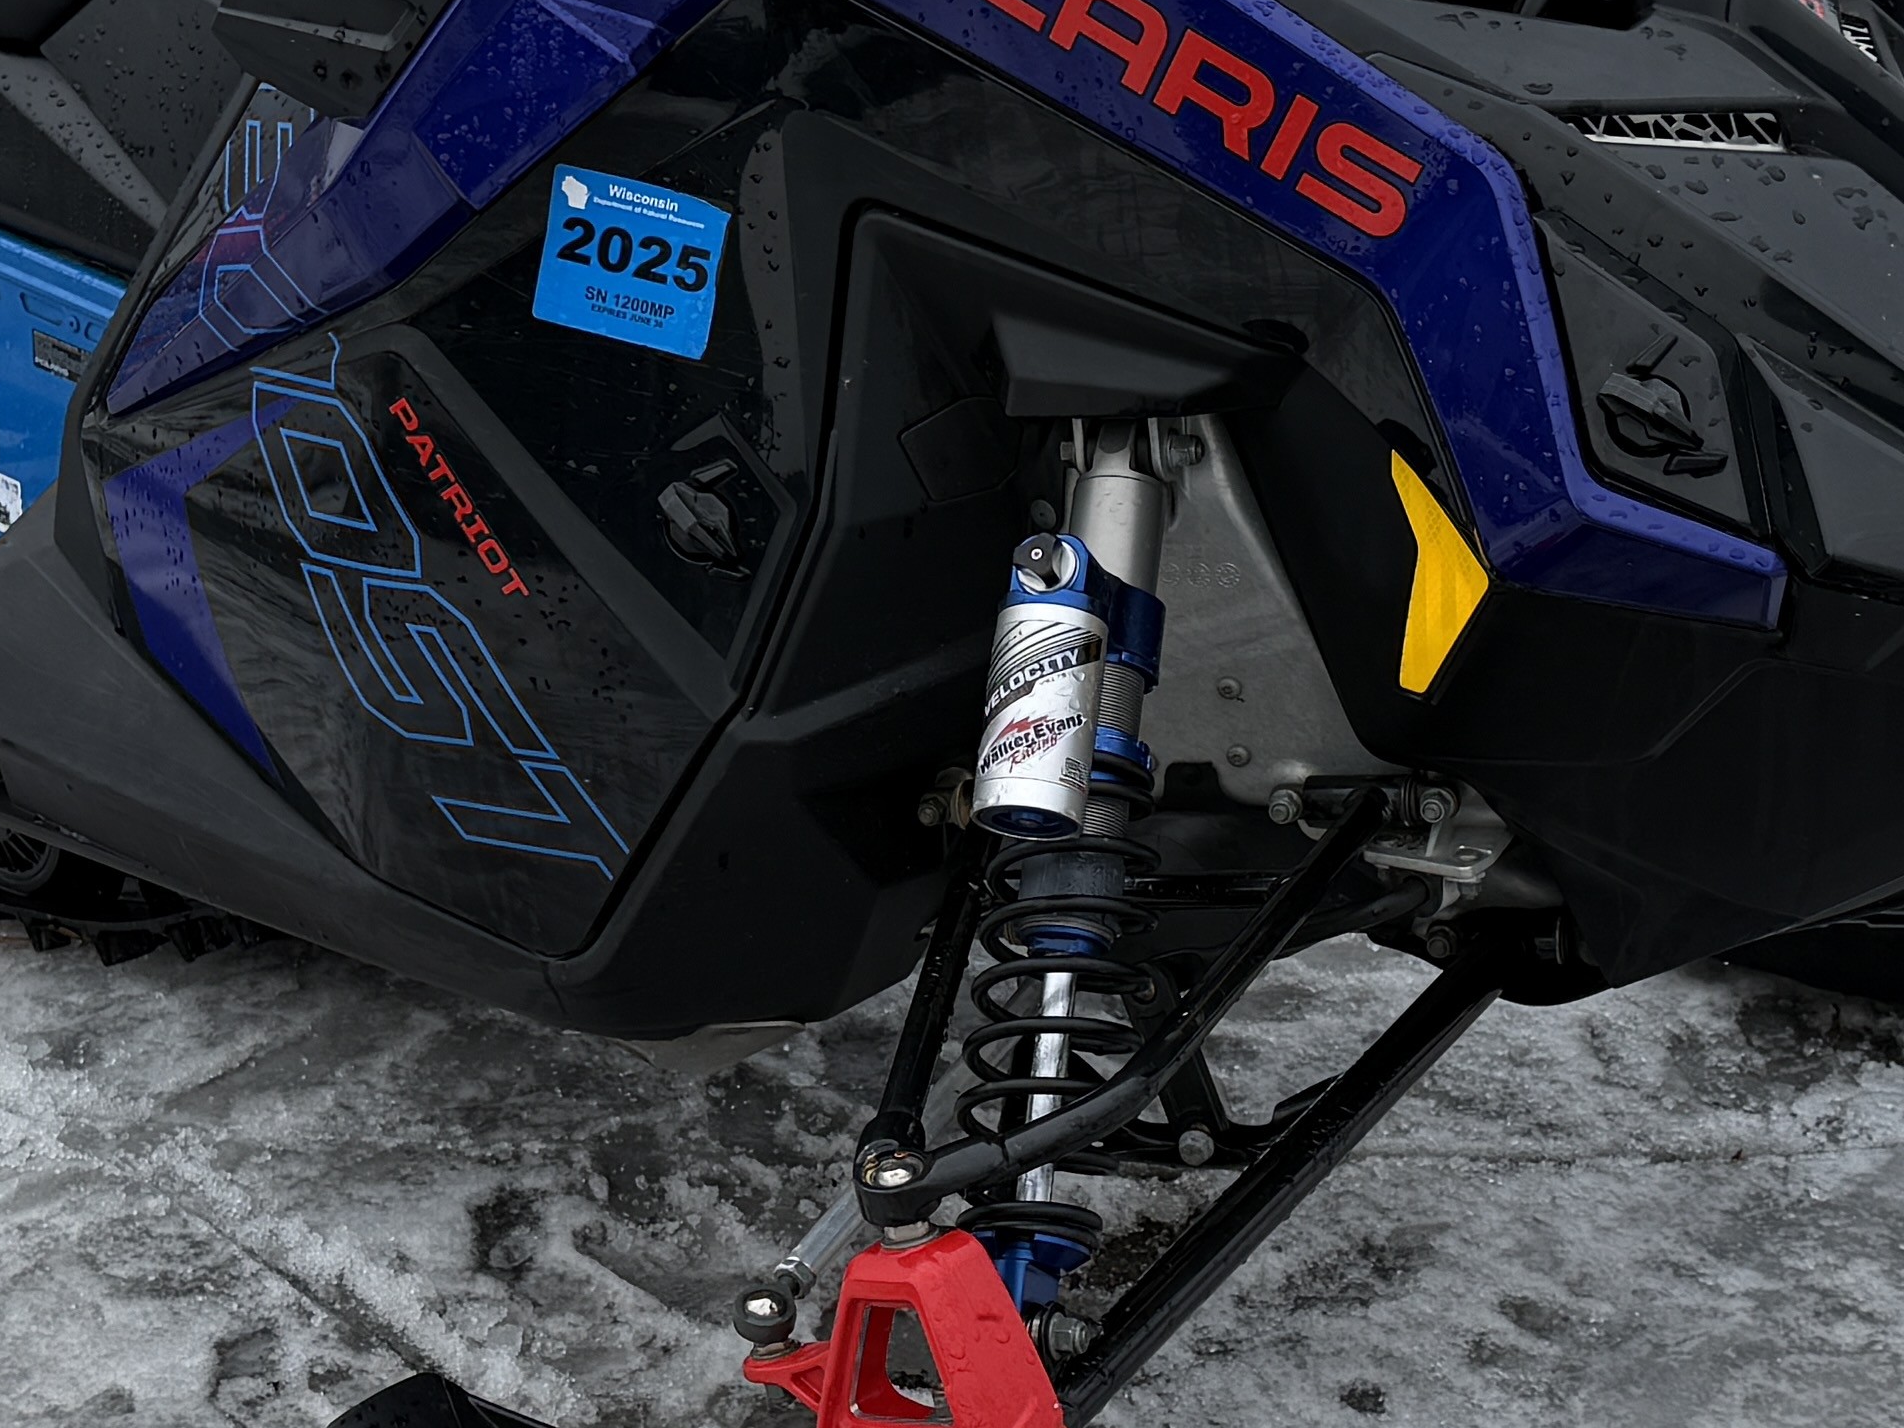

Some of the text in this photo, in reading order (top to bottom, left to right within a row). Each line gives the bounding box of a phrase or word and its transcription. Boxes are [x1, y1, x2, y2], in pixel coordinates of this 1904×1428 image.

[608, 183, 679, 213] Wisconsin
[556, 216, 712, 294] 2025
[584, 285, 675, 320] SN 1200MP
[388, 397, 530, 597] PATRIOT
[984, 648, 1079, 717] VELOCITY
[1032, 713, 1084, 739] Evans
